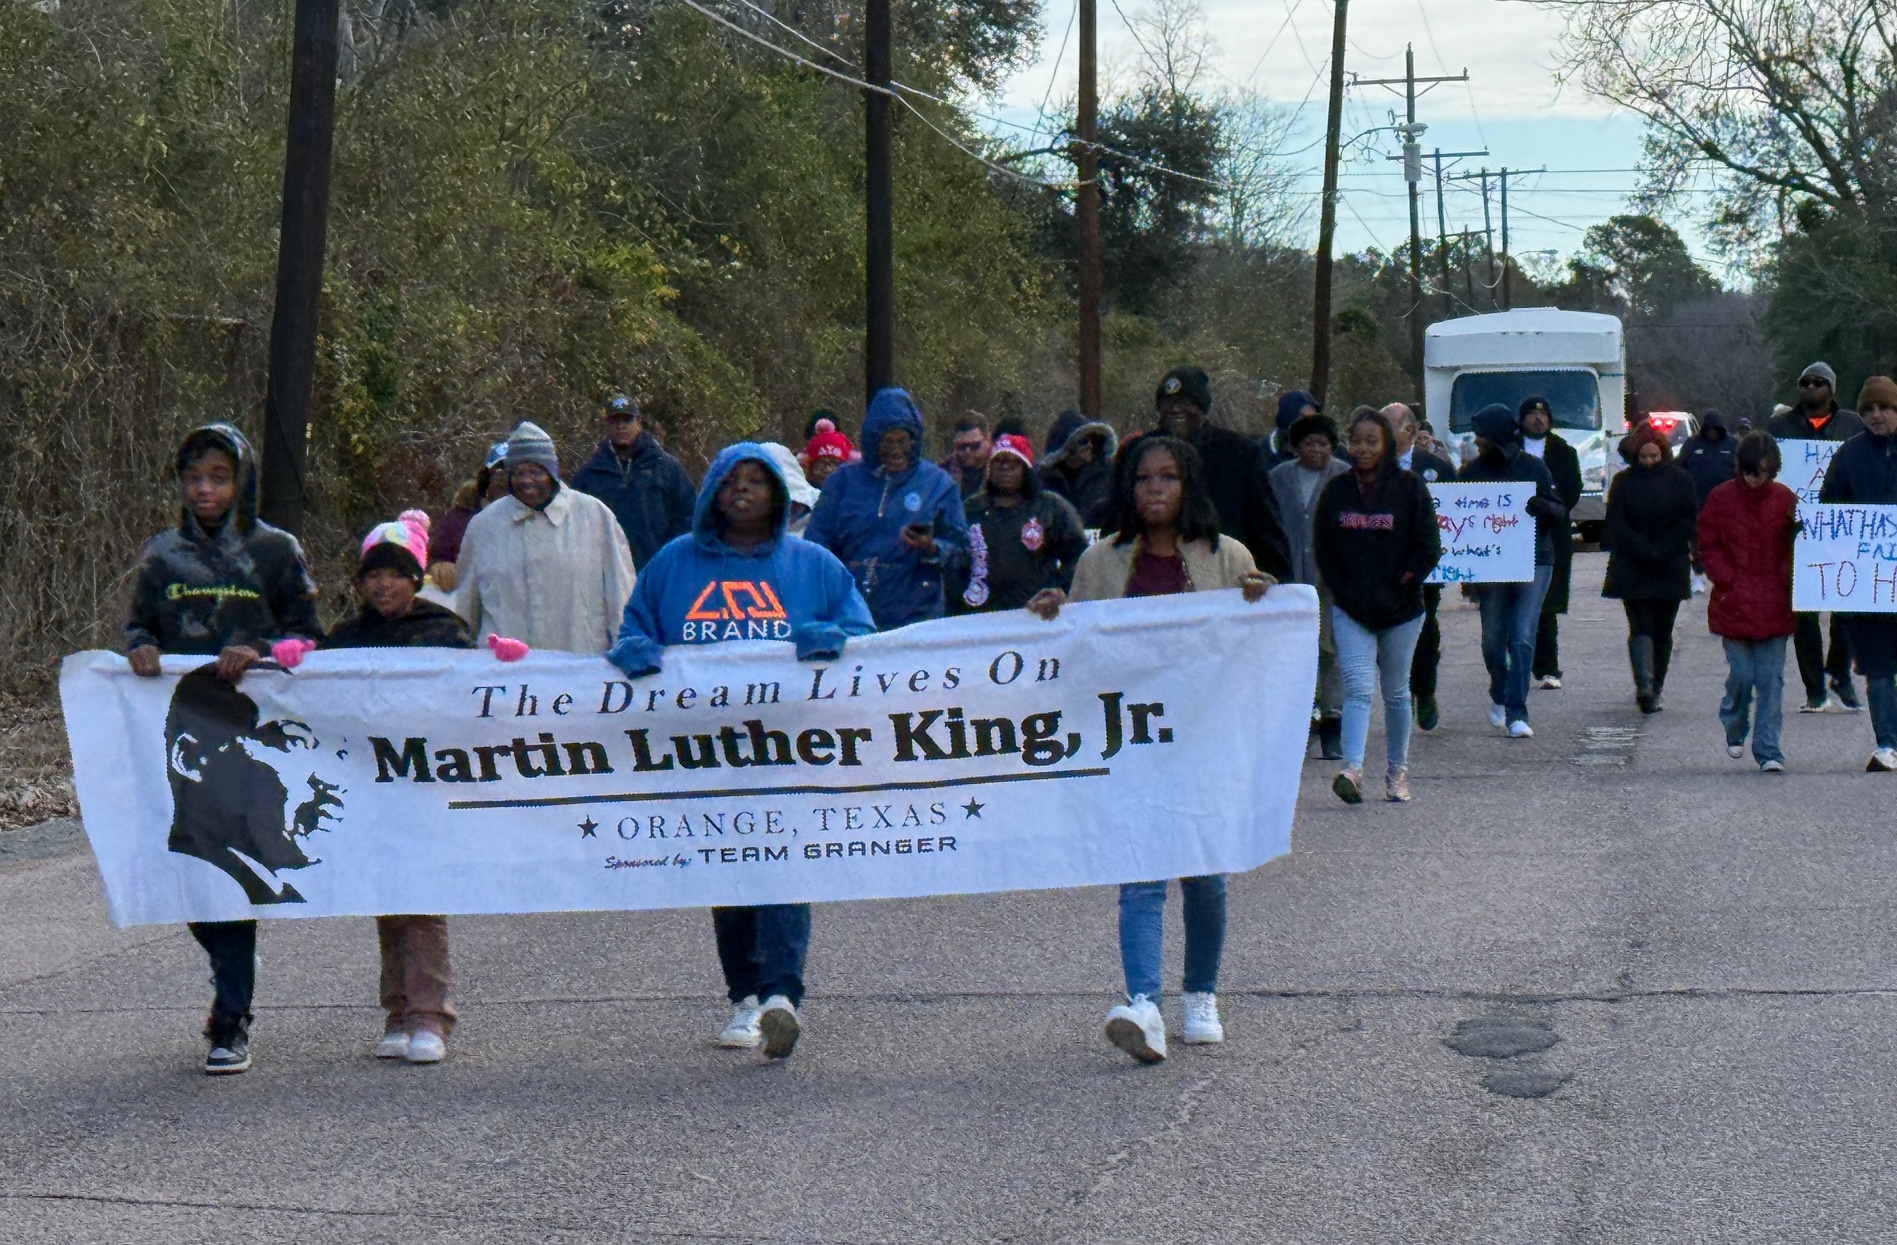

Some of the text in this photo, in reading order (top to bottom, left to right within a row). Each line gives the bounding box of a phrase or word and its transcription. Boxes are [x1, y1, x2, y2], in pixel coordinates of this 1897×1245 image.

[1436, 514, 1476, 543] ays
[1797, 508, 1862, 542] WHAT
[1806, 560, 1857, 601] TO
[682, 620, 792, 641] BRAND
[472, 650, 1060, 718] The Dream Lives On
[367, 691, 1174, 783] Martin Luther King, Jr.
[617, 802, 947, 840] ORANGE, TEXAS
[604, 855, 669, 870] Sponsored
[697, 846, 789, 865] TEAM
[803, 836, 958, 860] GRANGER
